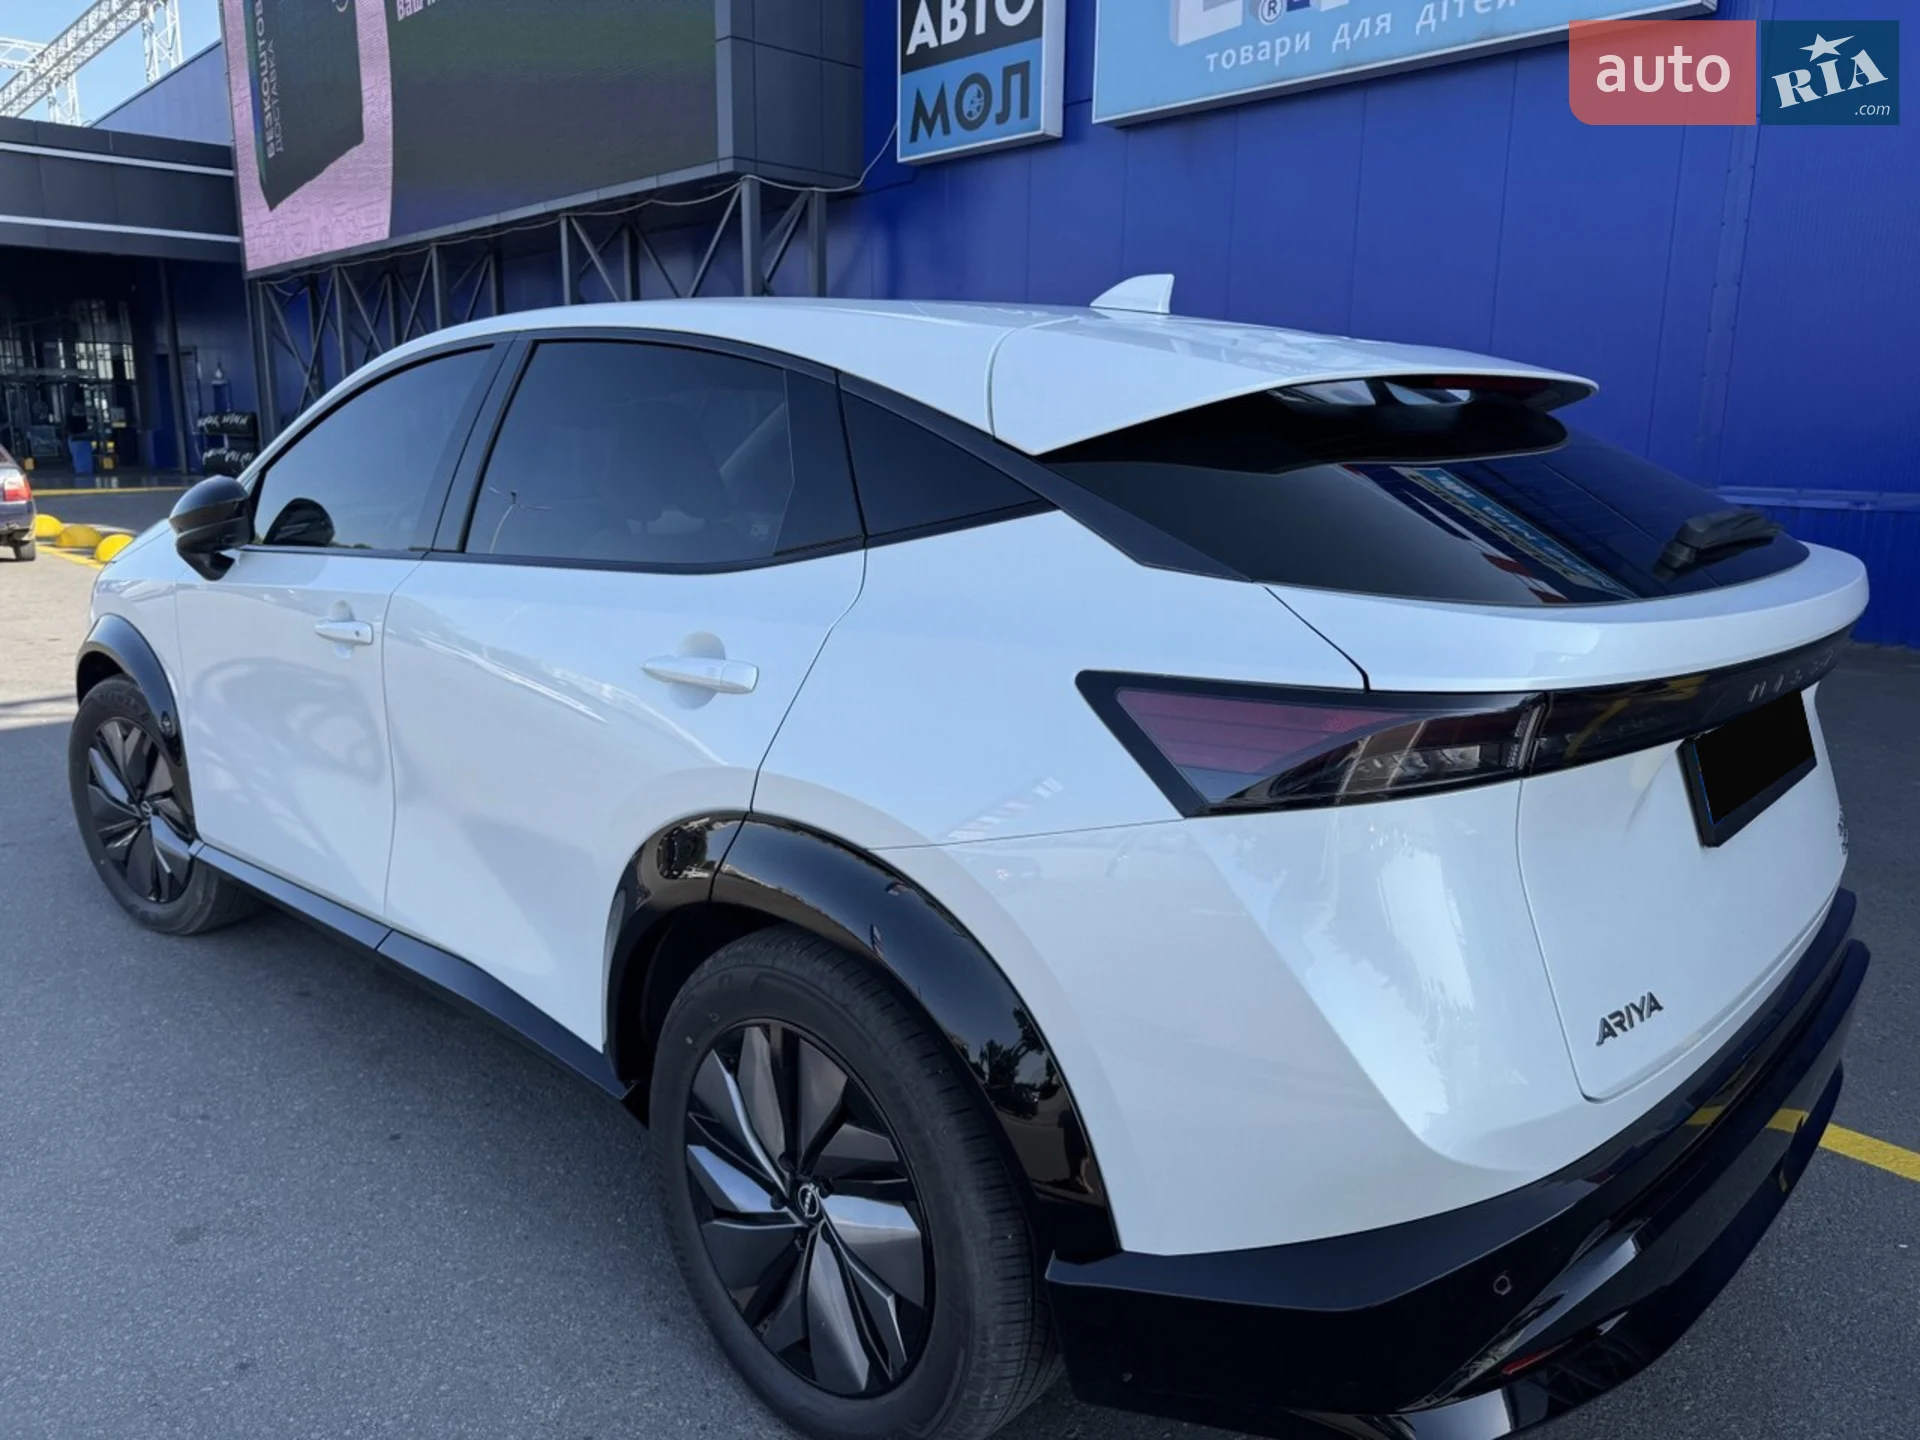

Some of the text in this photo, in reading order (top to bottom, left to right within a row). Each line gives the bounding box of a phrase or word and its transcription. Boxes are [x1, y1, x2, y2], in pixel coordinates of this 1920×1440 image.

[1206, 31, 1311, 72] товари
[1332, 12, 1392, 53] для
[267, 36, 284, 153] ДОСТАВКА
[909, 60, 1031, 144] МОЛ
[1596, 991, 1664, 1047] ARIYA
